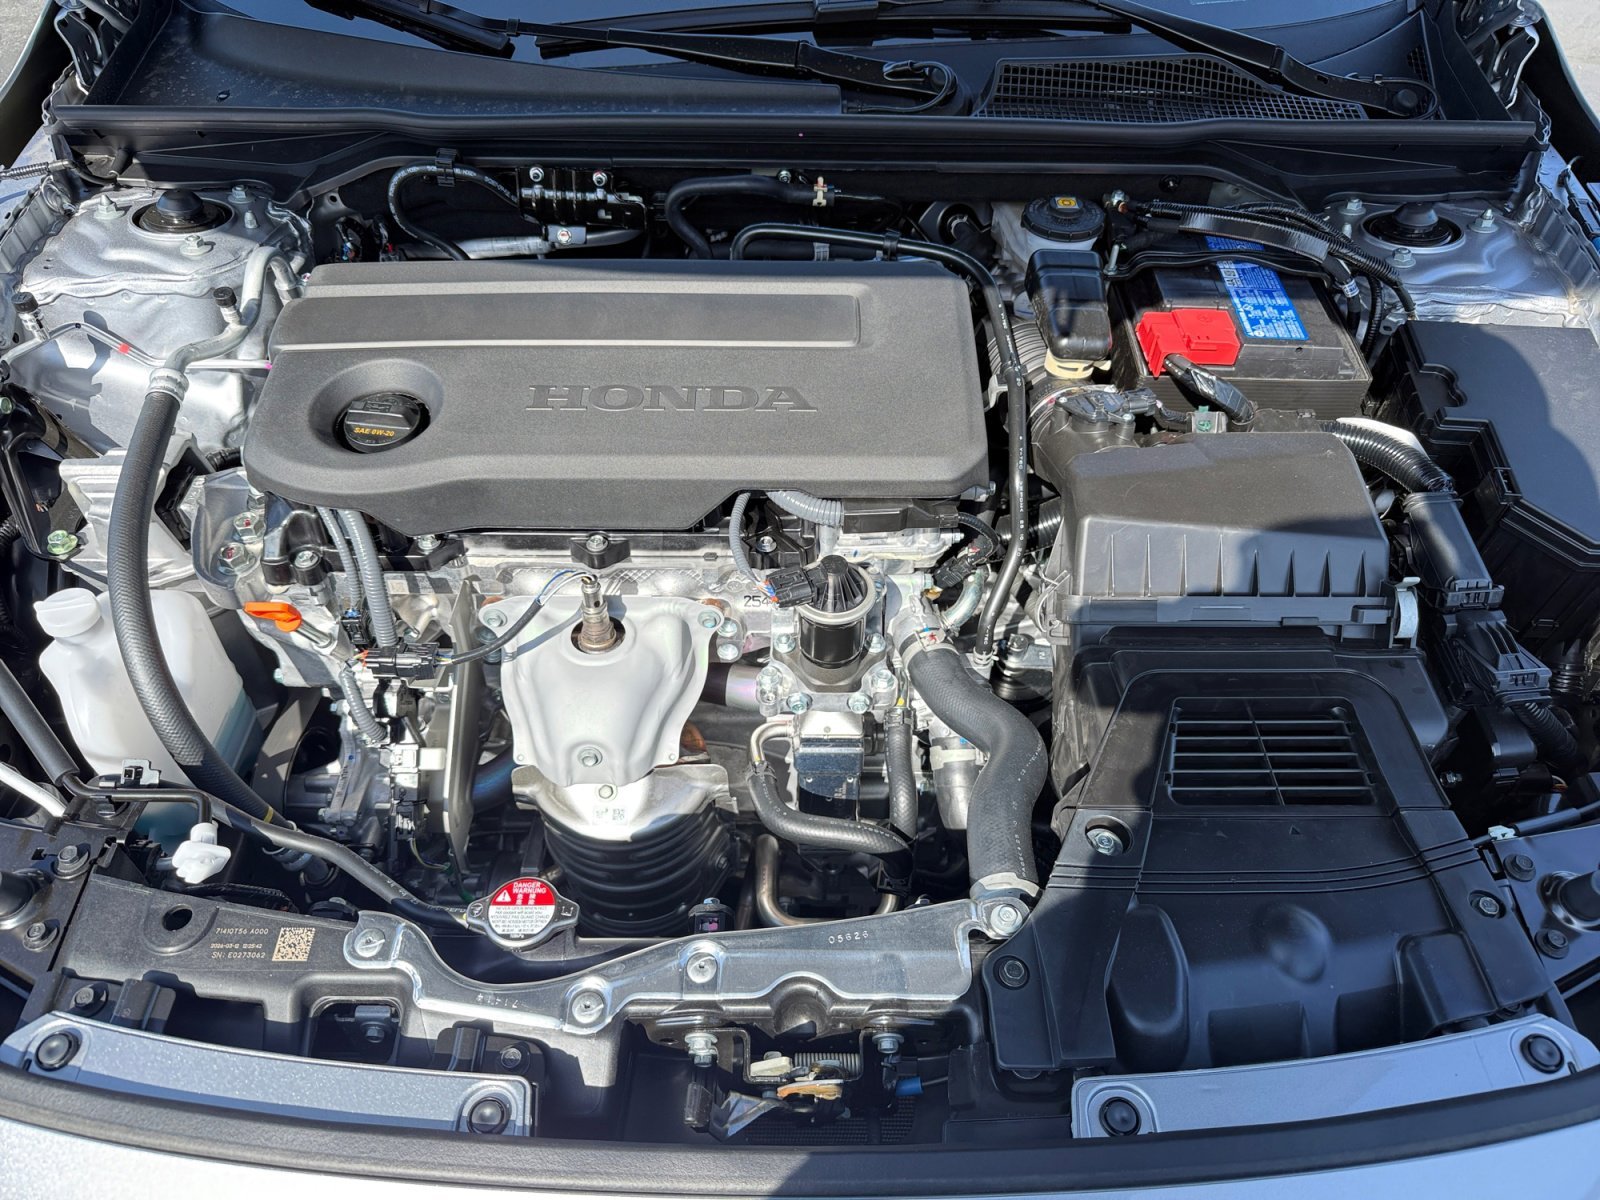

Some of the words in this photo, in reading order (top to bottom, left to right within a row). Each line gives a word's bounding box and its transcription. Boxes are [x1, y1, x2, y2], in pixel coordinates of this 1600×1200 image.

[525, 385, 818, 412] HONDA
[371, 429, 395, 437] 0W-20
[211, 951, 226, 959] SN:
[228, 951, 266, 959] E0273062
